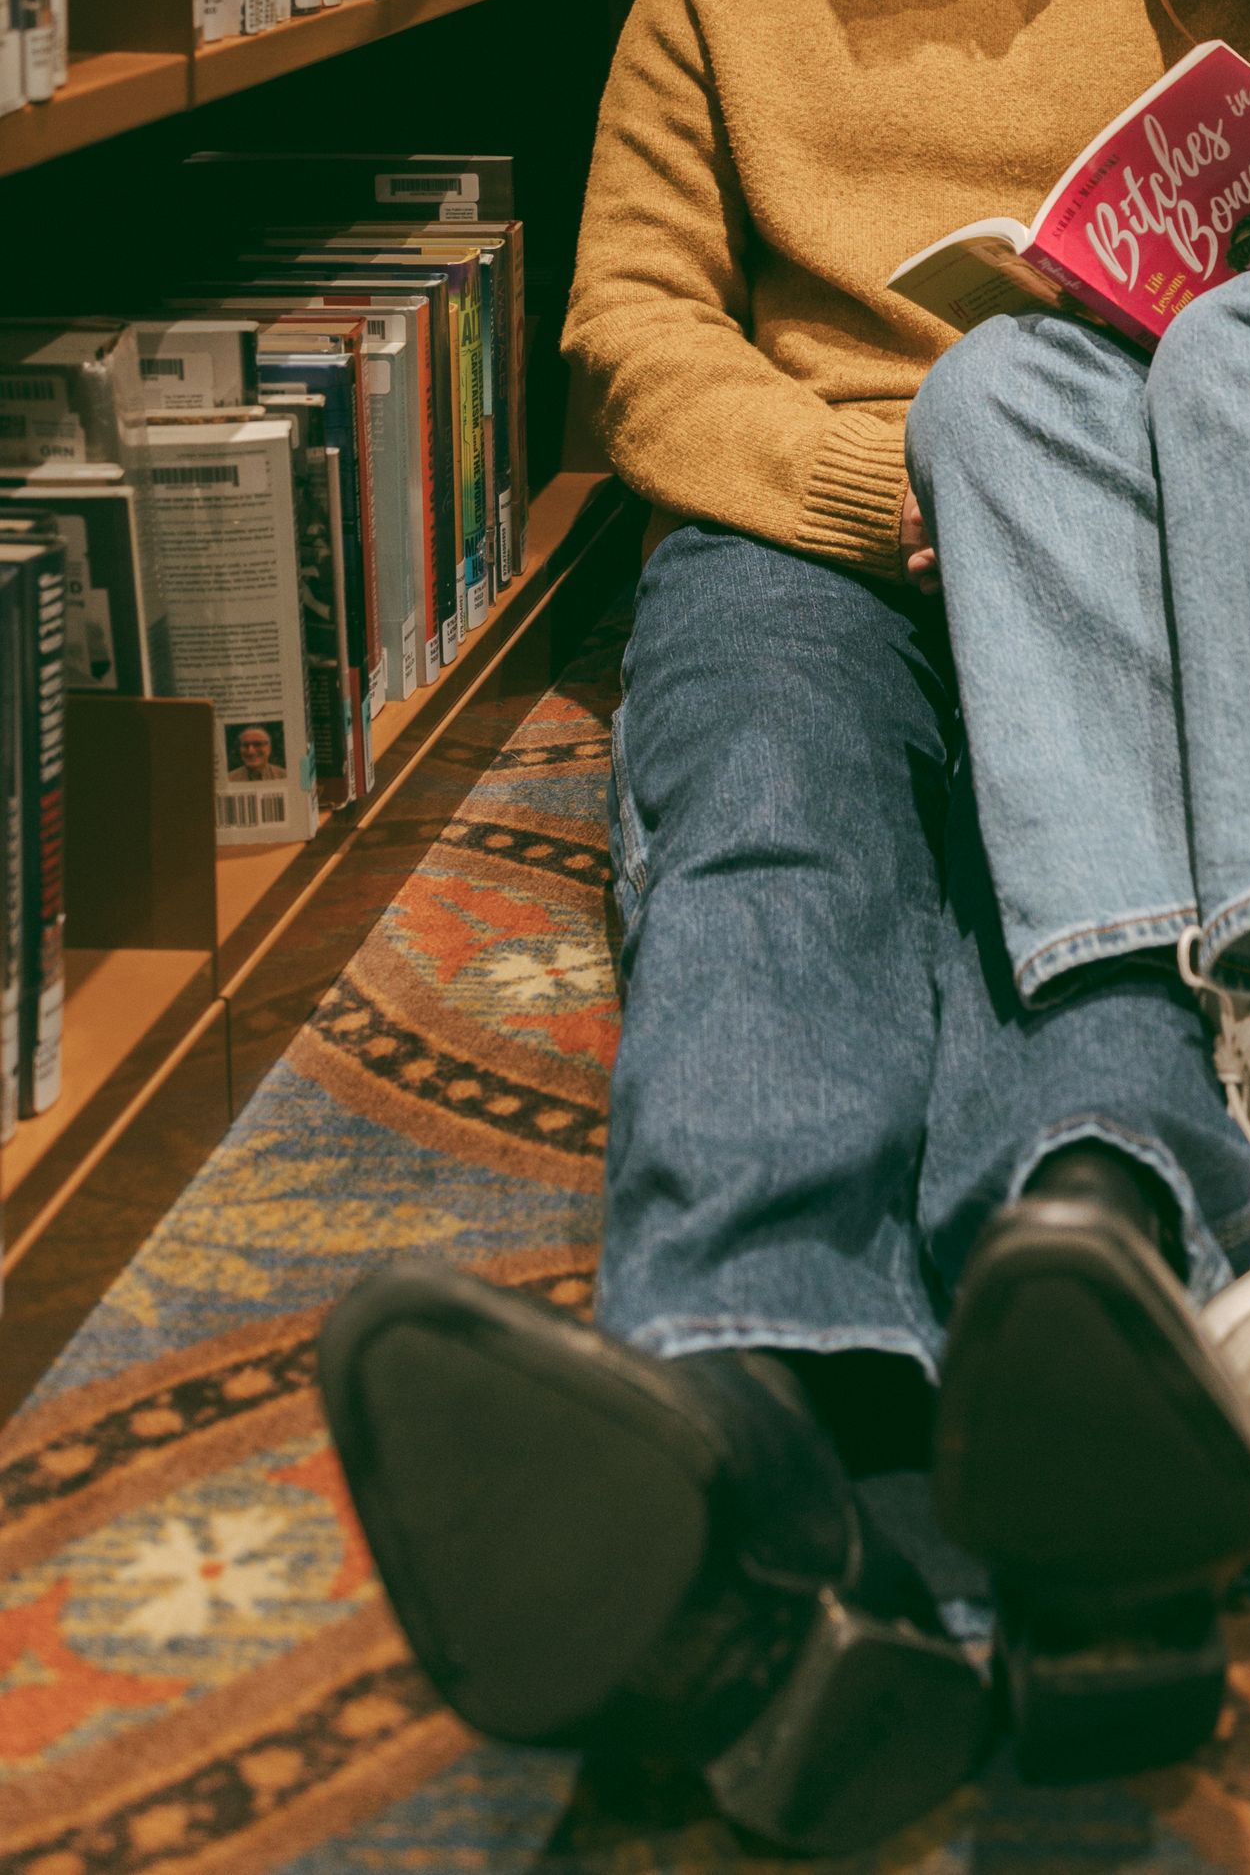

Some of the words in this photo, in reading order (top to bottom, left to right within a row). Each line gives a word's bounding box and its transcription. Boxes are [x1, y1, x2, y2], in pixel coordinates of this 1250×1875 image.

[1051, 206, 1077, 241] SARAH
[1085, 114, 1231, 293] Bitches
[1144, 270, 1165, 296] Life
[1151, 271, 1187, 317] Lessons
[1171, 288, 1194, 316] from
[471, 352, 481, 434] CAPITALISM,
[474, 477, 484, 524] WORLD
